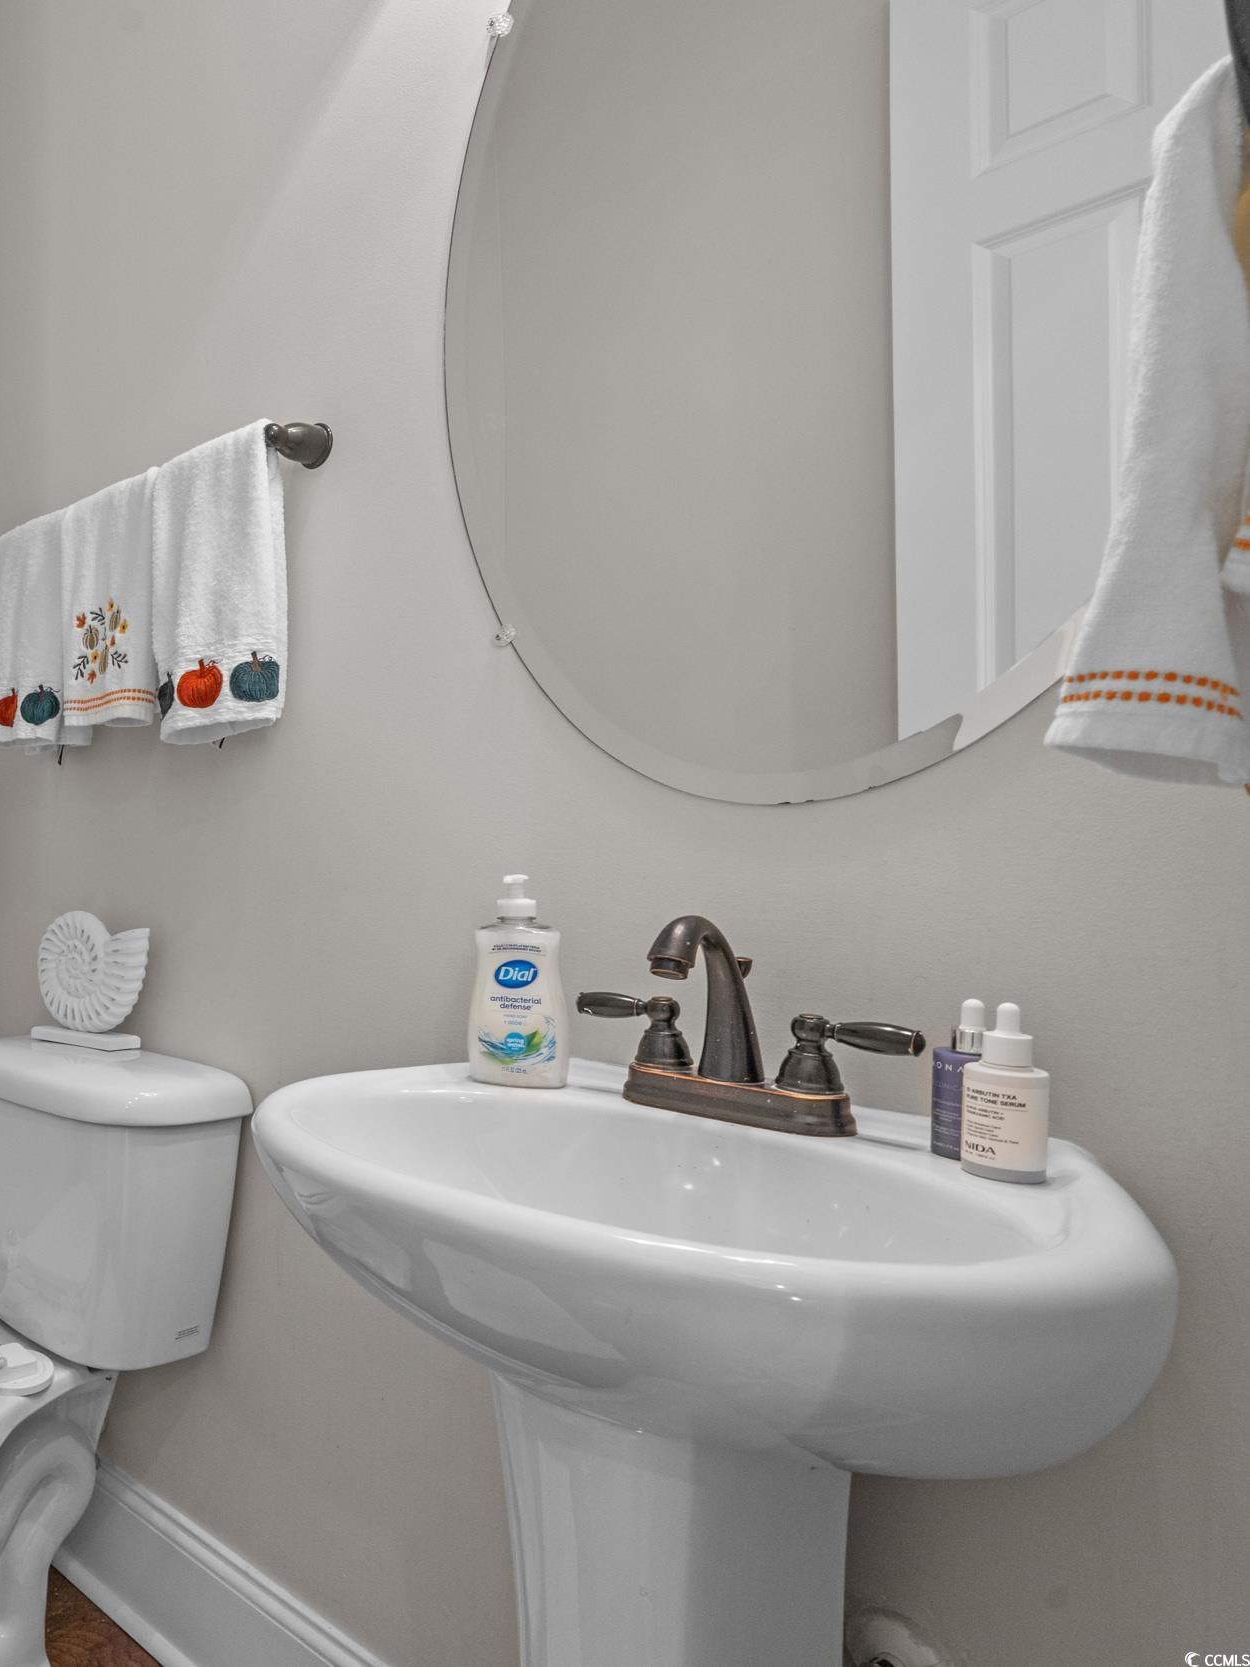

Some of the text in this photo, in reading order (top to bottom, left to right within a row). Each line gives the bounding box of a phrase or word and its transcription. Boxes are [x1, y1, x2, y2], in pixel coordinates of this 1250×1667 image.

[498, 966, 536, 982] Dial
[490, 995, 542, 1005] antibacterial
[499, 1002, 532, 1011] defense
[971, 1088, 1000, 1098] ARBUTIN
[1001, 1093, 1018, 1101] TXA
[980, 1097, 998, 1105] TONE
[965, 1140, 996, 1156] NIDA
